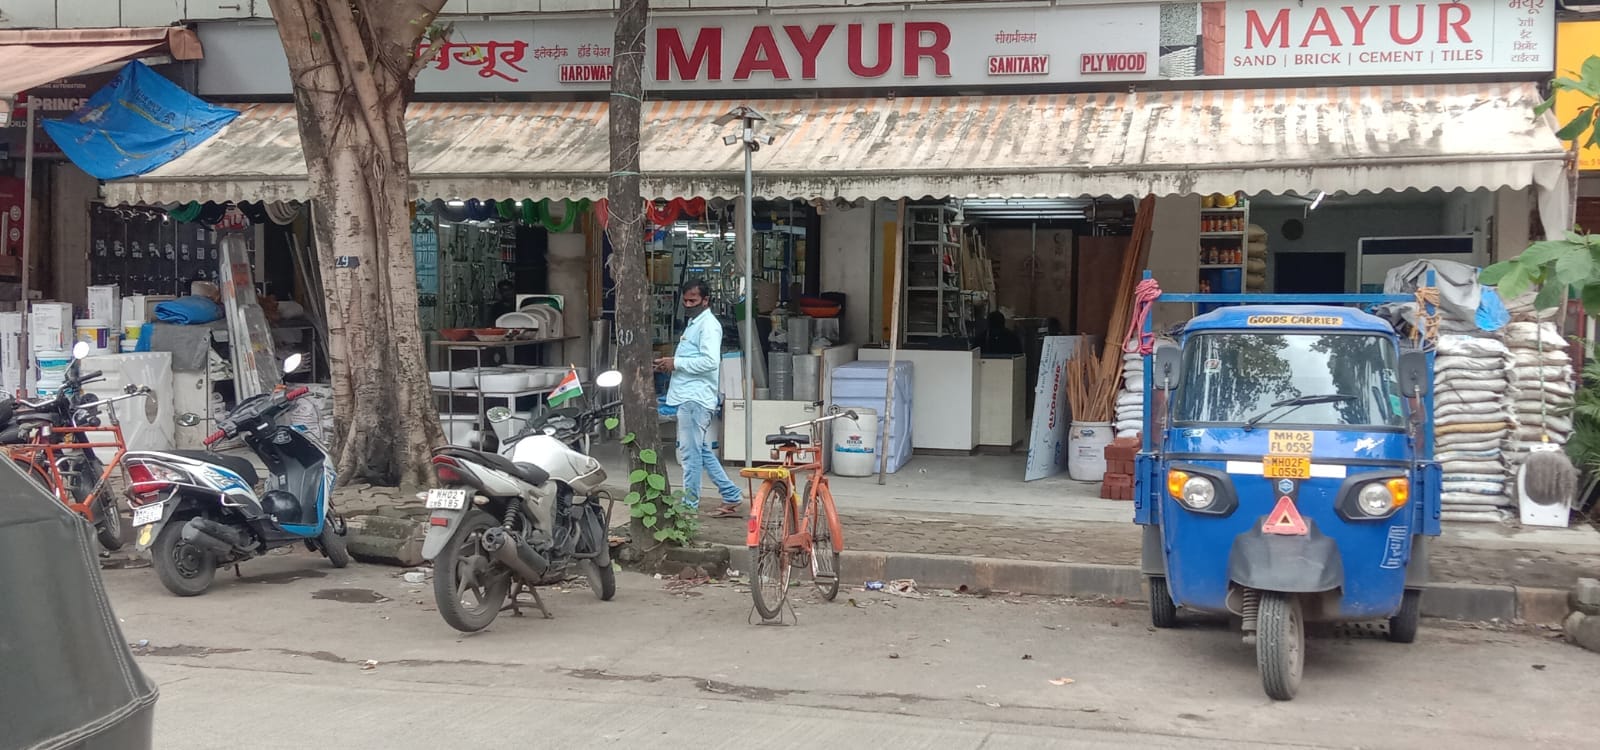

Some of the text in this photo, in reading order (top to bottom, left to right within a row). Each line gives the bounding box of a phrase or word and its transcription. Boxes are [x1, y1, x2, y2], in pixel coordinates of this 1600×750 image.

[1244, 2, 1473, 49] MAYUR
[655, 21, 953, 82] MAYUR
[1233, 50, 1484, 67] SAND BRICK CEMENT TILES
[990, 56, 1048, 73] SANITARY
[1082, 54, 1145, 72] PLYWOOD
[561, 65, 613, 81] HARDWAR
[1249, 316, 1341, 325] GOODS CARRIER
